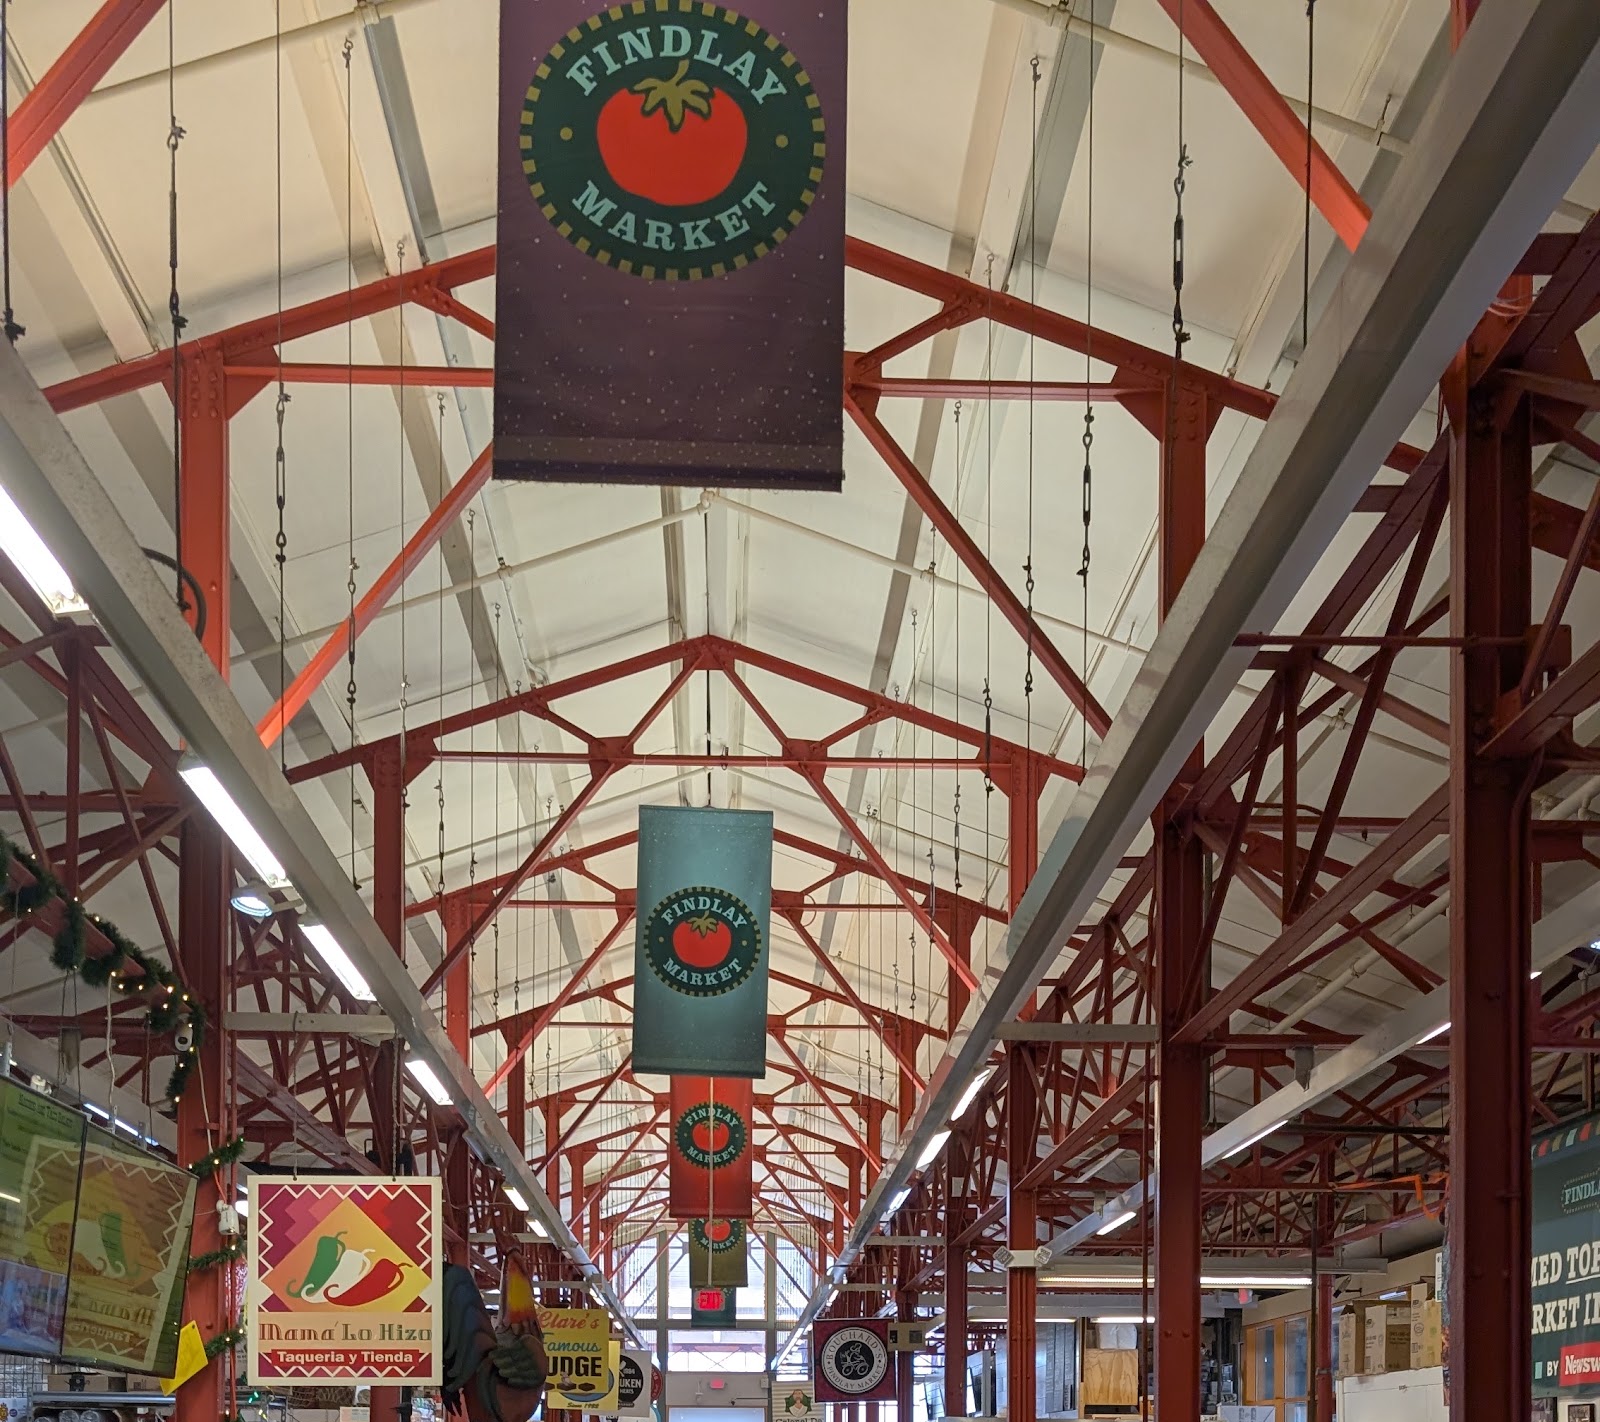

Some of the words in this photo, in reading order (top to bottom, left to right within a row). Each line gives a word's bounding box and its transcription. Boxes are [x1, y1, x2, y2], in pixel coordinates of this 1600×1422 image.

[565, 25, 787, 105] FINDLAY
[571, 180, 778, 252] MARKET
[661, 896, 748, 929] FINDLAY
[662, 957, 743, 986] MARKET
[685, 1107, 739, 1127] FINDLAY
[687, 1145, 737, 1163] MARKET
[1564, 1180, 1600, 1205] FINDL
[342, 1323, 372, 1341] Lo
[379, 1323, 432, 1341] Hizo
[277, 1351, 345, 1366] Taqueria
[349, 1353, 358, 1365] y
[361, 1351, 413, 1363] Tienda
[826, 1331, 883, 1361] BOUCHARD'S
[857, 1365, 883, 1390] MARKET
[1546, 1360, 1559, 1377] BY
